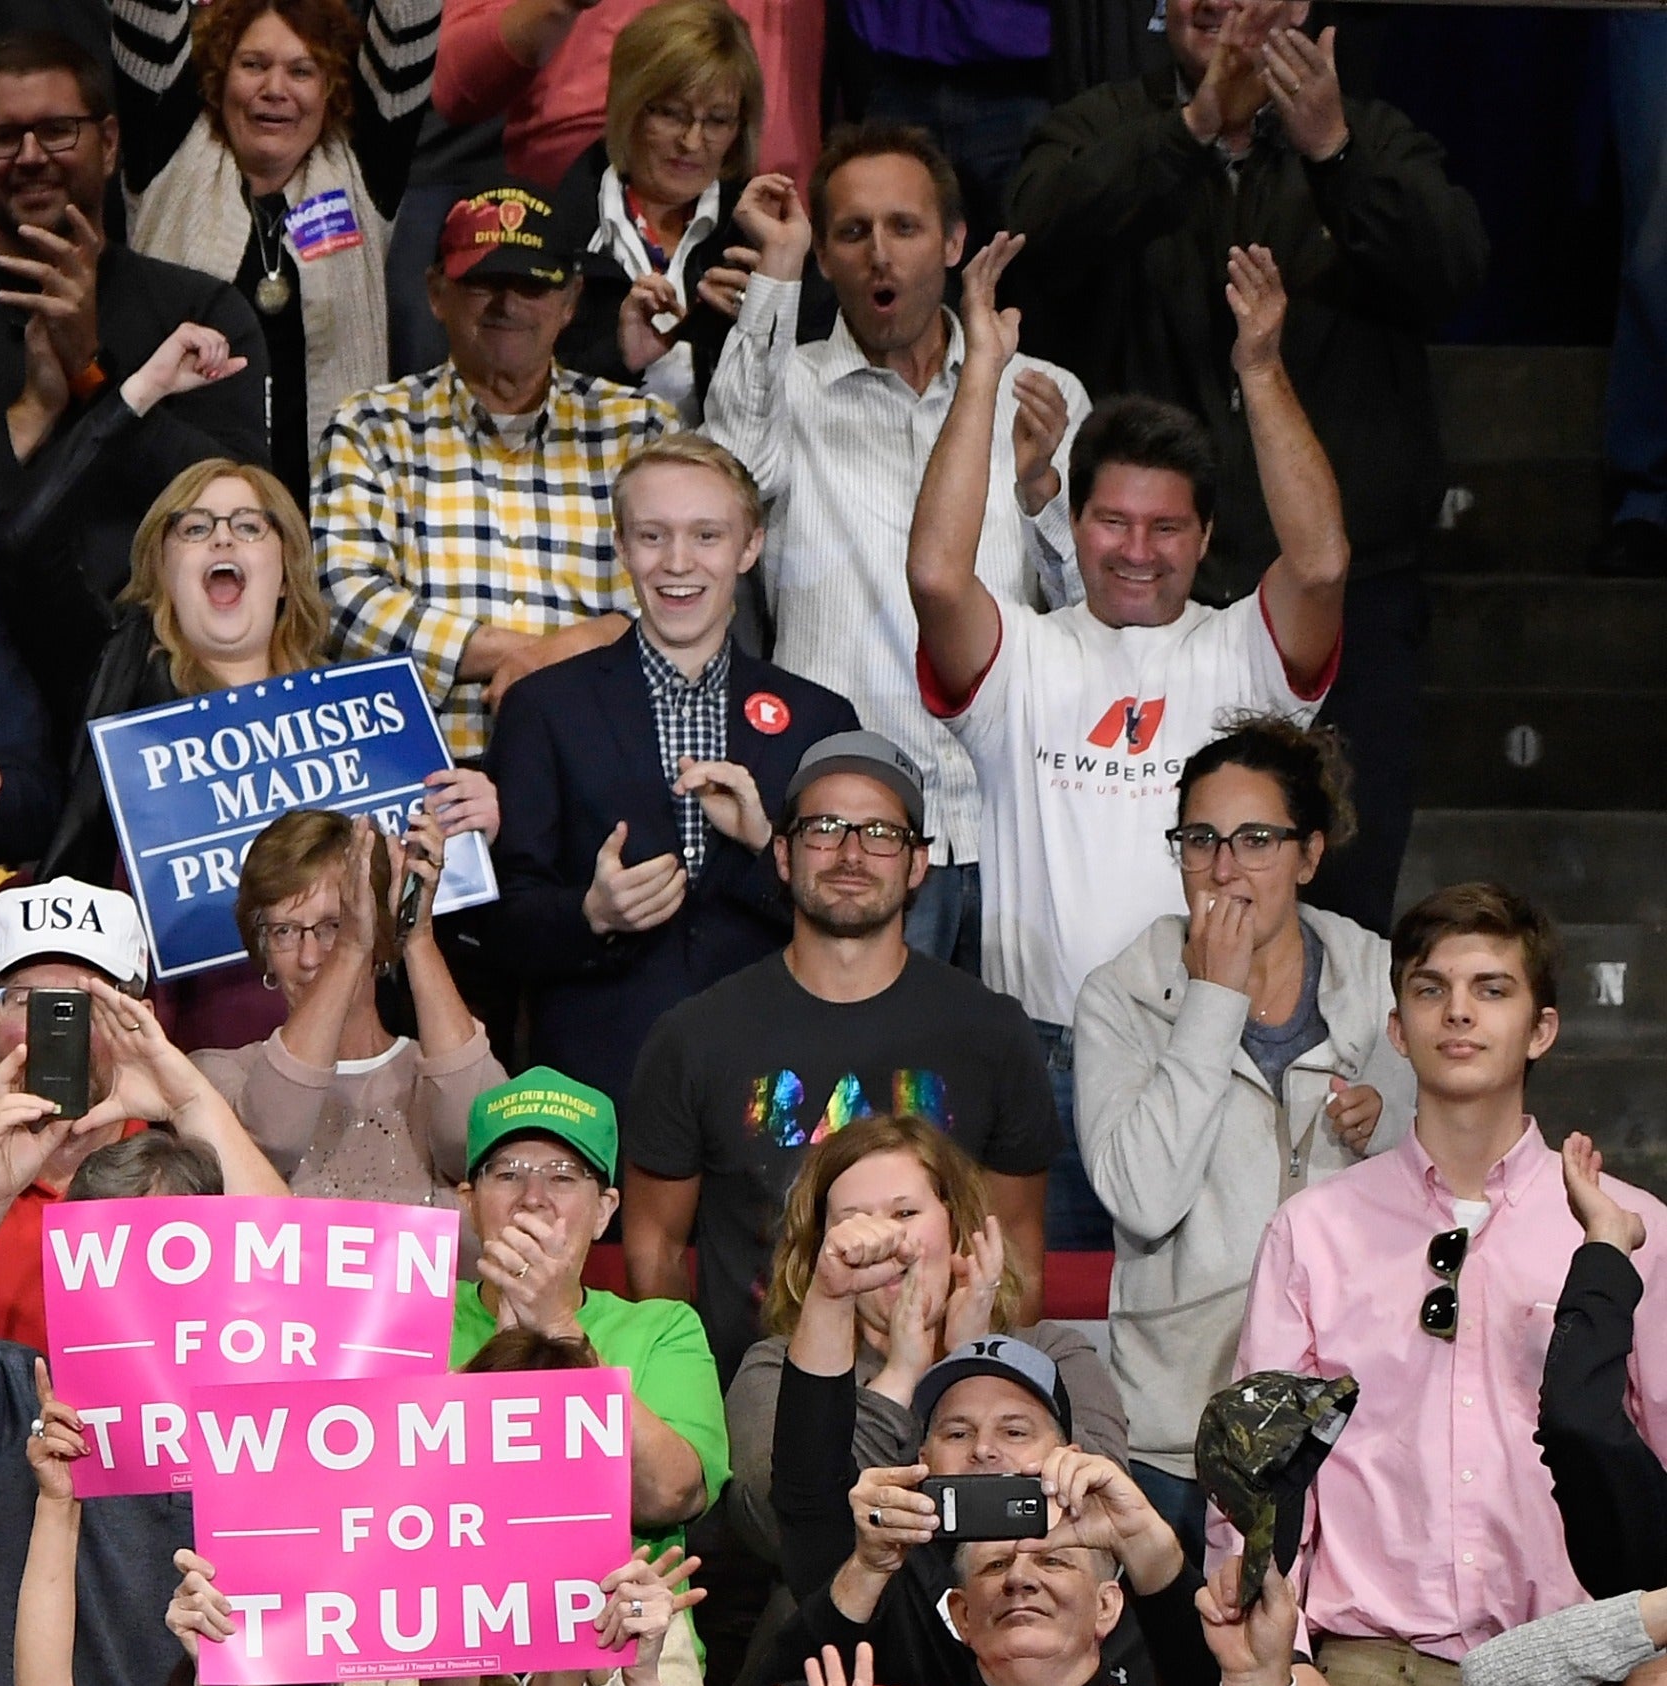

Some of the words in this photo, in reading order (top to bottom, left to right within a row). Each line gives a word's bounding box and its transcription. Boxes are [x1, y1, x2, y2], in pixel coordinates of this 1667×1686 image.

[475, 231, 543, 249] DIVISION
[139, 693, 405, 791] PROMISES
[212, 753, 370, 825] MADE
[1051, 779, 1083, 791] FOR
[1097, 784, 1118, 795] US
[18, 896, 105, 935] USA
[487, 1094, 518, 1114] MAKE
[520, 1090, 544, 1101] OUR
[546, 1091, 596, 1118] FARMERS
[503, 1103, 539, 1120] GREAT
[51, 1220, 451, 1299] WOMEN
[174, 1320, 318, 1367] FOR
[197, 1394, 624, 1476] WOMEN
[342, 1504, 485, 1554] FOR
[228, 1580, 606, 1659] TRUMP
[340, 1665, 356, 1674] Paid
[357, 1665, 367, 1673] for
[368, 1665, 378, 1674] by
[379, 1663, 405, 1673] Donald
[412, 1661, 435, 1672] Trump
[436, 1660, 447, 1669] for
